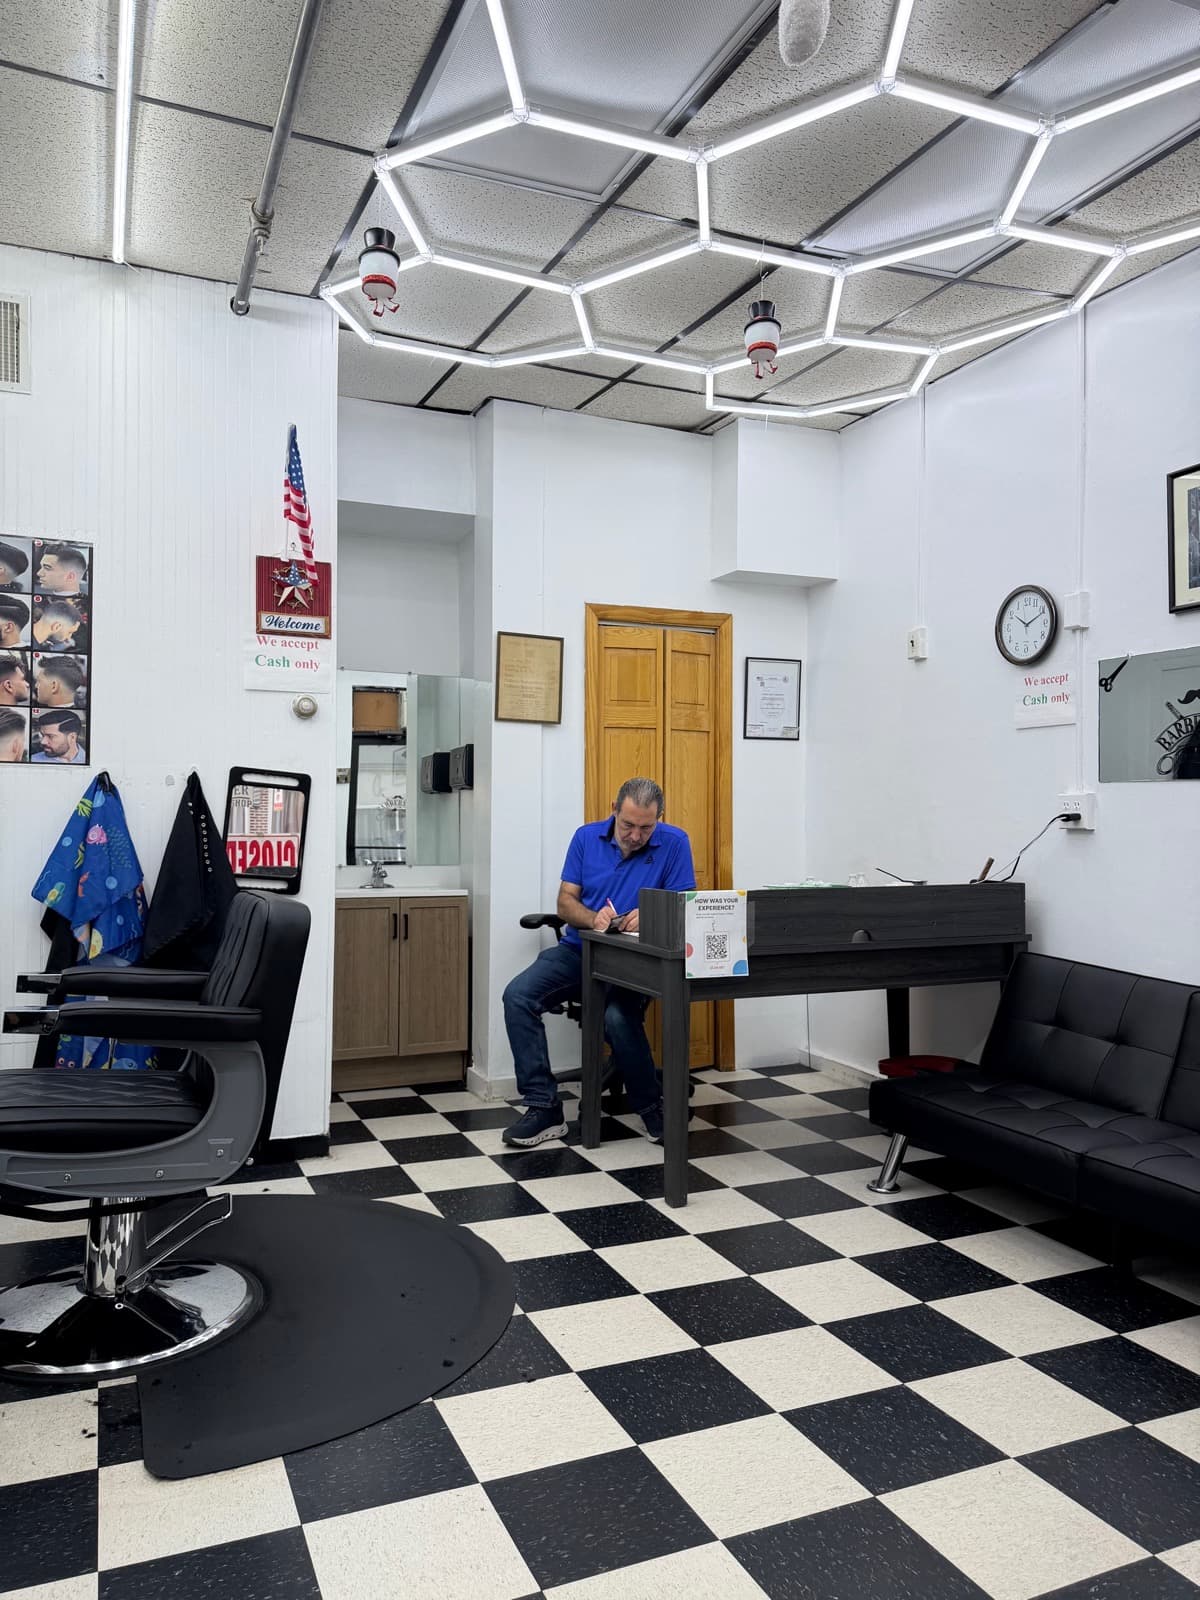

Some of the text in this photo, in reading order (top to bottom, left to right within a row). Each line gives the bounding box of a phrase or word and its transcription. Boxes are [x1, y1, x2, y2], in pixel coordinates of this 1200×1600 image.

[264, 614, 322, 631] Welcome
[256, 635, 320, 651] We accept
[254, 654, 321, 672] Cash only
[1024, 673, 1069, 686] We accept
[1022, 692, 1071, 706] Cash only
